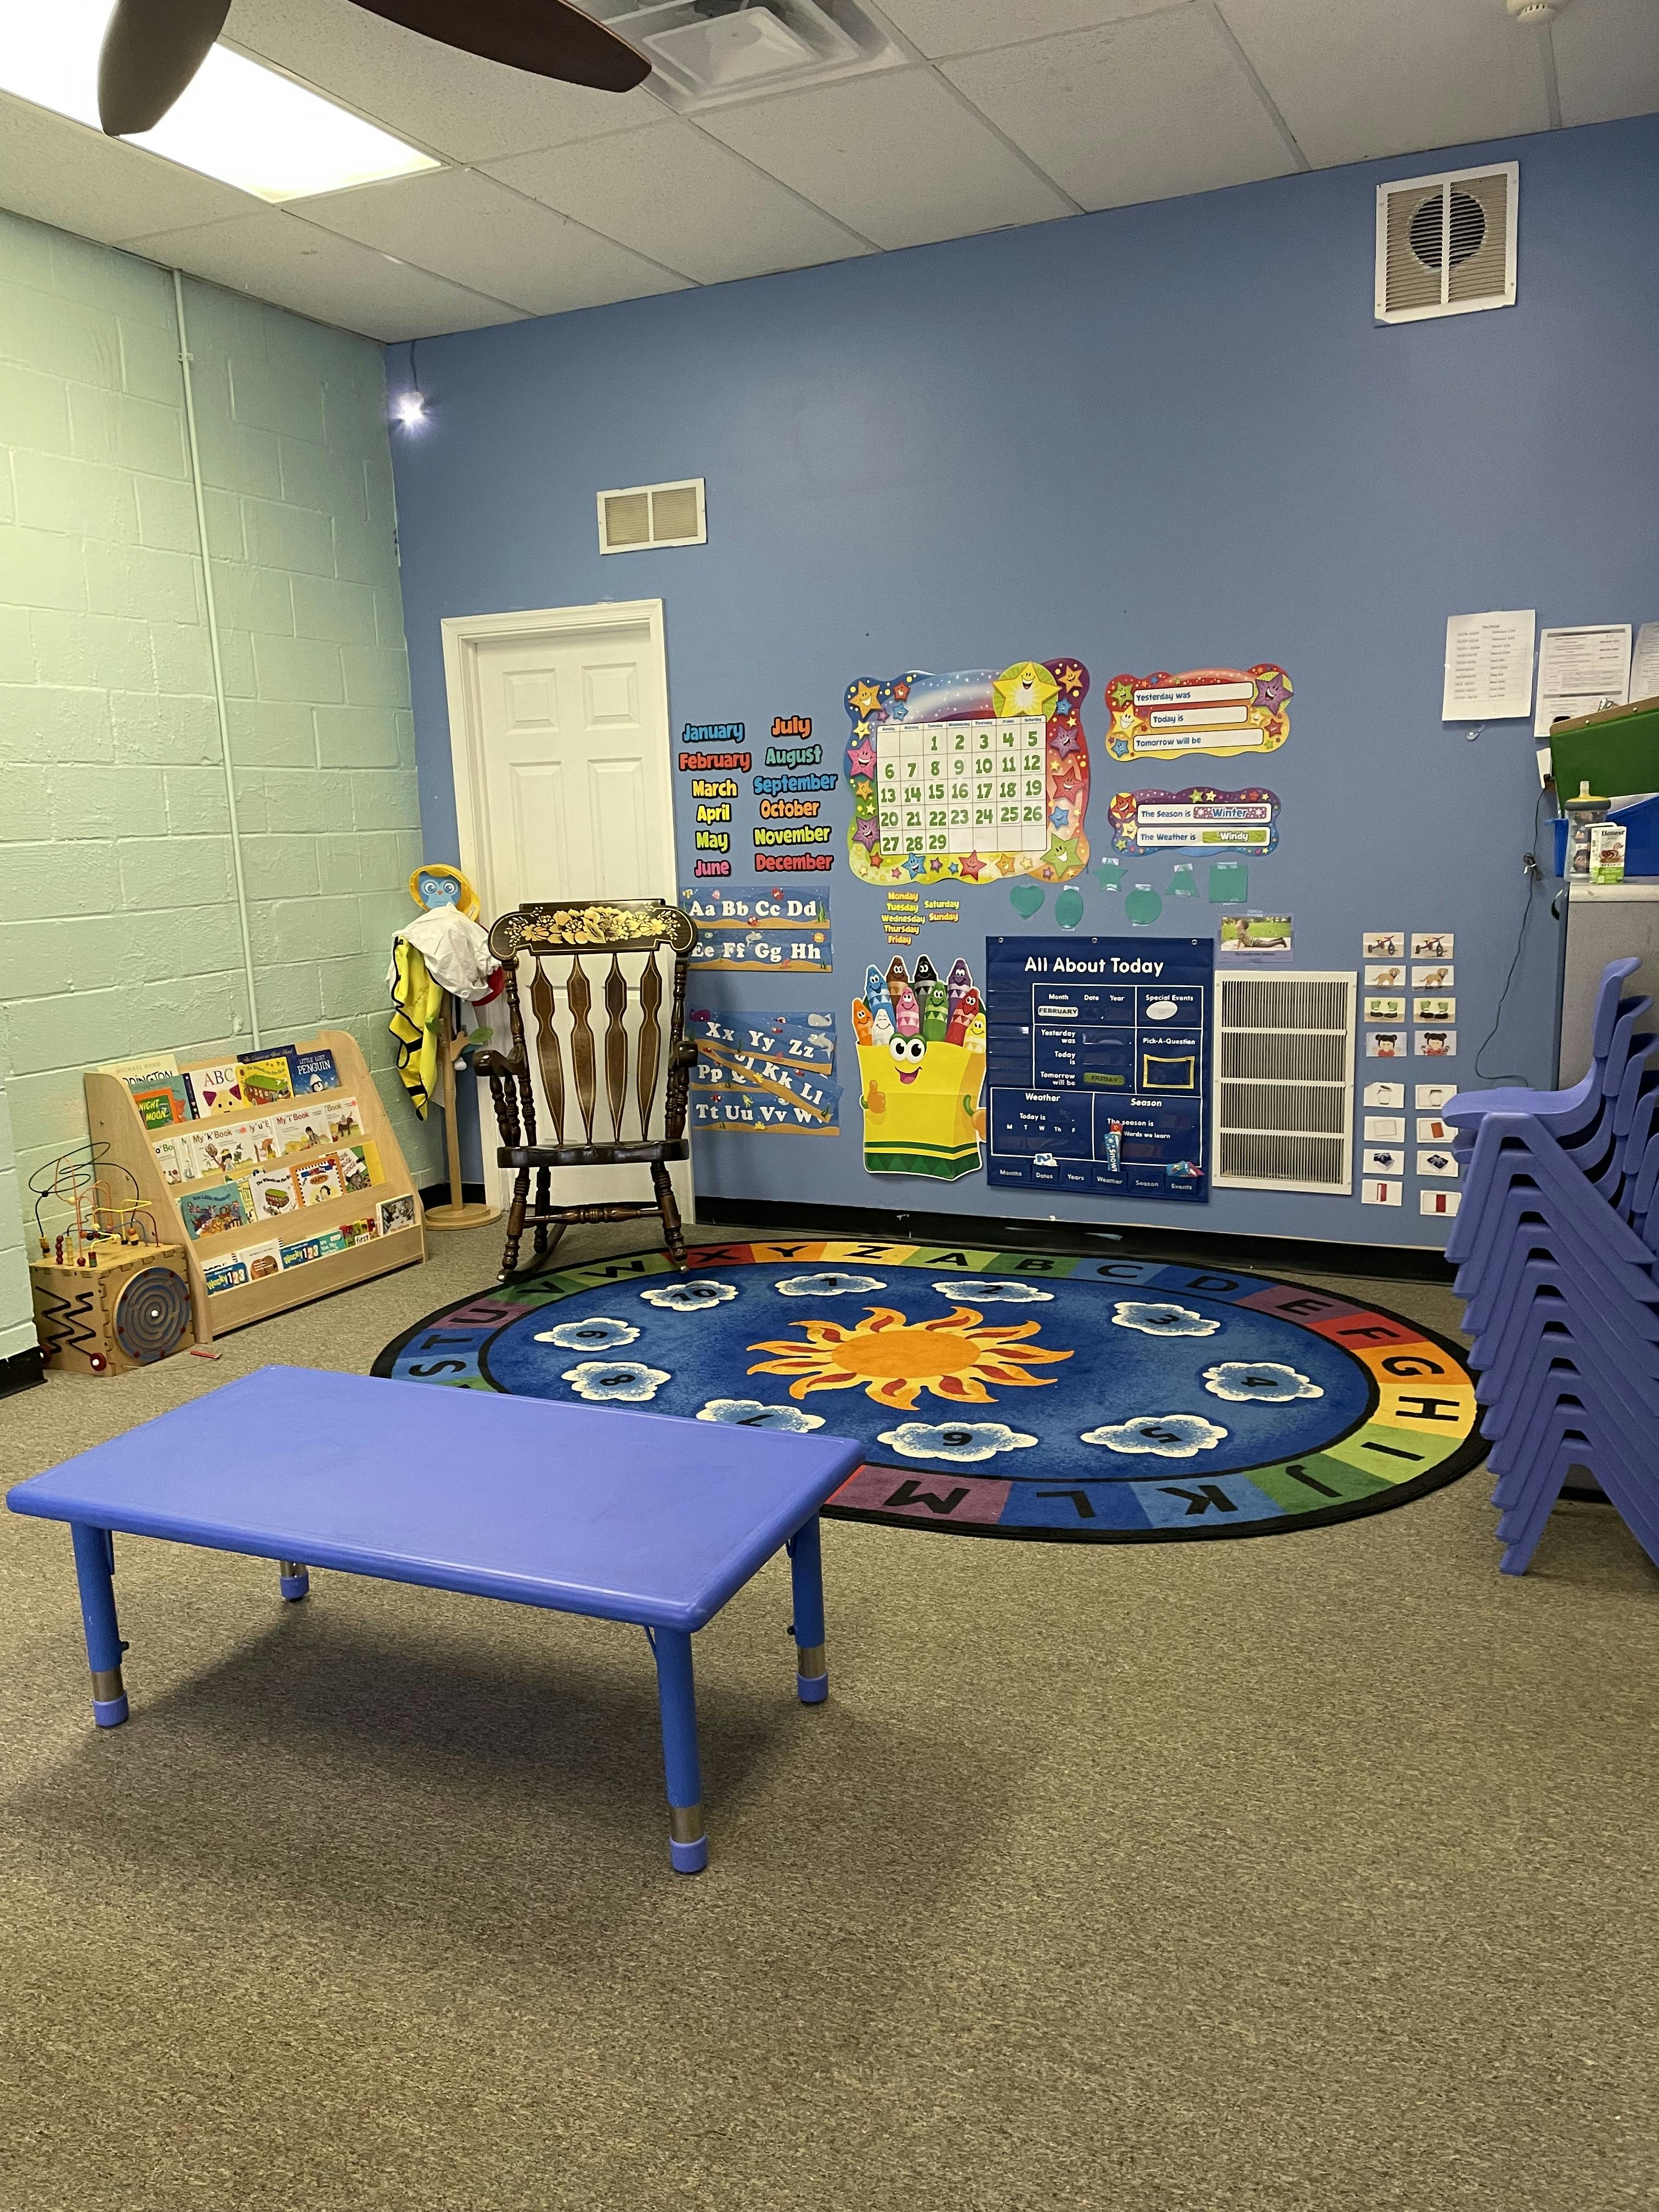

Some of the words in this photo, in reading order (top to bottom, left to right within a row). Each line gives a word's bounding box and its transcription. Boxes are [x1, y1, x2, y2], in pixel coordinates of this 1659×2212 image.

[1136, 693, 1173, 701] Yesterday
[1153, 715, 1176, 723] Today
[682, 723, 744, 743] January
[771, 716, 812, 739] July
[932, 736, 938, 751] 1
[955, 735, 964, 749] 2
[980, 734, 989, 749] 3
[1003, 732, 1014, 747] 4
[1028, 731, 1037, 746] 5
[1136, 738, 1174, 747] Tomorrow
[679, 752, 752, 773] February
[765, 744, 822, 770] August
[885, 764, 895, 778] 6
[907, 763, 916, 777] 7
[931, 761, 940, 776] 8
[954, 760, 964, 775] 9
[976, 758, 992, 774] 10
[1002, 757, 1015, 772] 11
[1024, 754, 1040, 770] 12
[692, 778, 738, 798] March
[753, 774, 838, 795] September
[696, 803, 732, 825] April
[760, 799, 820, 819] October
[1212, 807, 1248, 818] Winter
[929, 811, 946, 826] 22
[975, 809, 993, 824] 24
[695, 830, 730, 851] May
[753, 825, 832, 847] November
[882, 837, 899, 851] 27
[906, 836, 923, 851] 28
[929, 834, 946, 849] 29
[1220, 832, 1249, 842] Windy
[694, 859, 731, 877] June
[754, 853, 834, 871] December
[888, 891, 919, 902] Monday
[689, 900, 715, 917] Aa
[721, 900, 749, 917] Bb
[755, 900, 780, 917] Cc
[787, 900, 817, 917] Dd
[887, 902, 919, 913] Tuesday
[924, 900, 960, 910] Saturday
[881, 914, 926, 924] Wednesday
[928, 912, 959, 922] Sunday
[884, 924, 920, 935] Thursday
[888, 935, 912, 945] Friday
[691, 942, 714, 957] Ee
[723, 943, 746, 958] Ff
[754, 943, 782, 962] Gg
[791, 943, 821, 960] Hh
[1024, 956, 1047, 972] All
[1053, 957, 1105, 973] About
[1110, 957, 1164, 977] Today
[706, 1022, 735, 1041] Xx
[748, 1030, 775, 1052] Yy
[789, 1039, 814, 1058] Zz
[1041, 1029, 1076, 1037] Yesterday
[298, 1056, 314, 1065] LITTLE
[1054, 1051, 1076, 1059] Today
[144, 1061, 161, 1069] BOND
[296, 1060, 331, 1075] PENGUIN
[698, 1064, 723, 1082] Pp
[204, 1068, 235, 1087] ABC
[1041, 1071, 1075, 1079] Tomorrow
[762, 1062, 793, 1089] Kk
[800, 1082, 823, 1105] Ll
[1025, 1092, 1060, 1102] Weather
[1131, 1098, 1162, 1107] Season
[146, 1109, 166, 1121] MOON
[293, 1111, 309, 1121] Book
[327, 1104, 343, 1112] Book
[696, 1104, 719, 1119] Tt
[725, 1105, 753, 1120] Uu
[760, 1106, 787, 1122] Vv
[1019, 1113, 1039, 1121] Today
[193, 1135, 204, 1144] My
[214, 1128, 233, 1138] Book
[1097, 1176, 1123, 1184] Weather
[698, 1248, 737, 1263] X
[769, 1245, 808, 1258] Y
[848, 1245, 895, 1259] Z
[924, 1252, 969, 1267] A
[579, 1260, 646, 1279] W
[1014, 1259, 1054, 1271] B
[1097, 1264, 1143, 1279] C
[1186, 1275, 1239, 1292] D
[671, 1289, 717, 1301] 10
[1274, 1298, 1334, 1316] E
[449, 1307, 509, 1324] U
[1146, 1313, 1180, 1326] 3
[1336, 1327, 1401, 1340] F
[421, 1334, 473, 1350] T
[408, 1359, 467, 1377] S
[1381, 1356, 1445, 1376] G
[1395, 1396, 1460, 1422] H
[1139, 1426, 1182, 1443] 5
[1285, 1464, 1343, 1498] J
[883, 1480, 971, 1515] M
[1036, 1490, 1096, 1518] L
[1155, 1485, 1239, 1516] K
